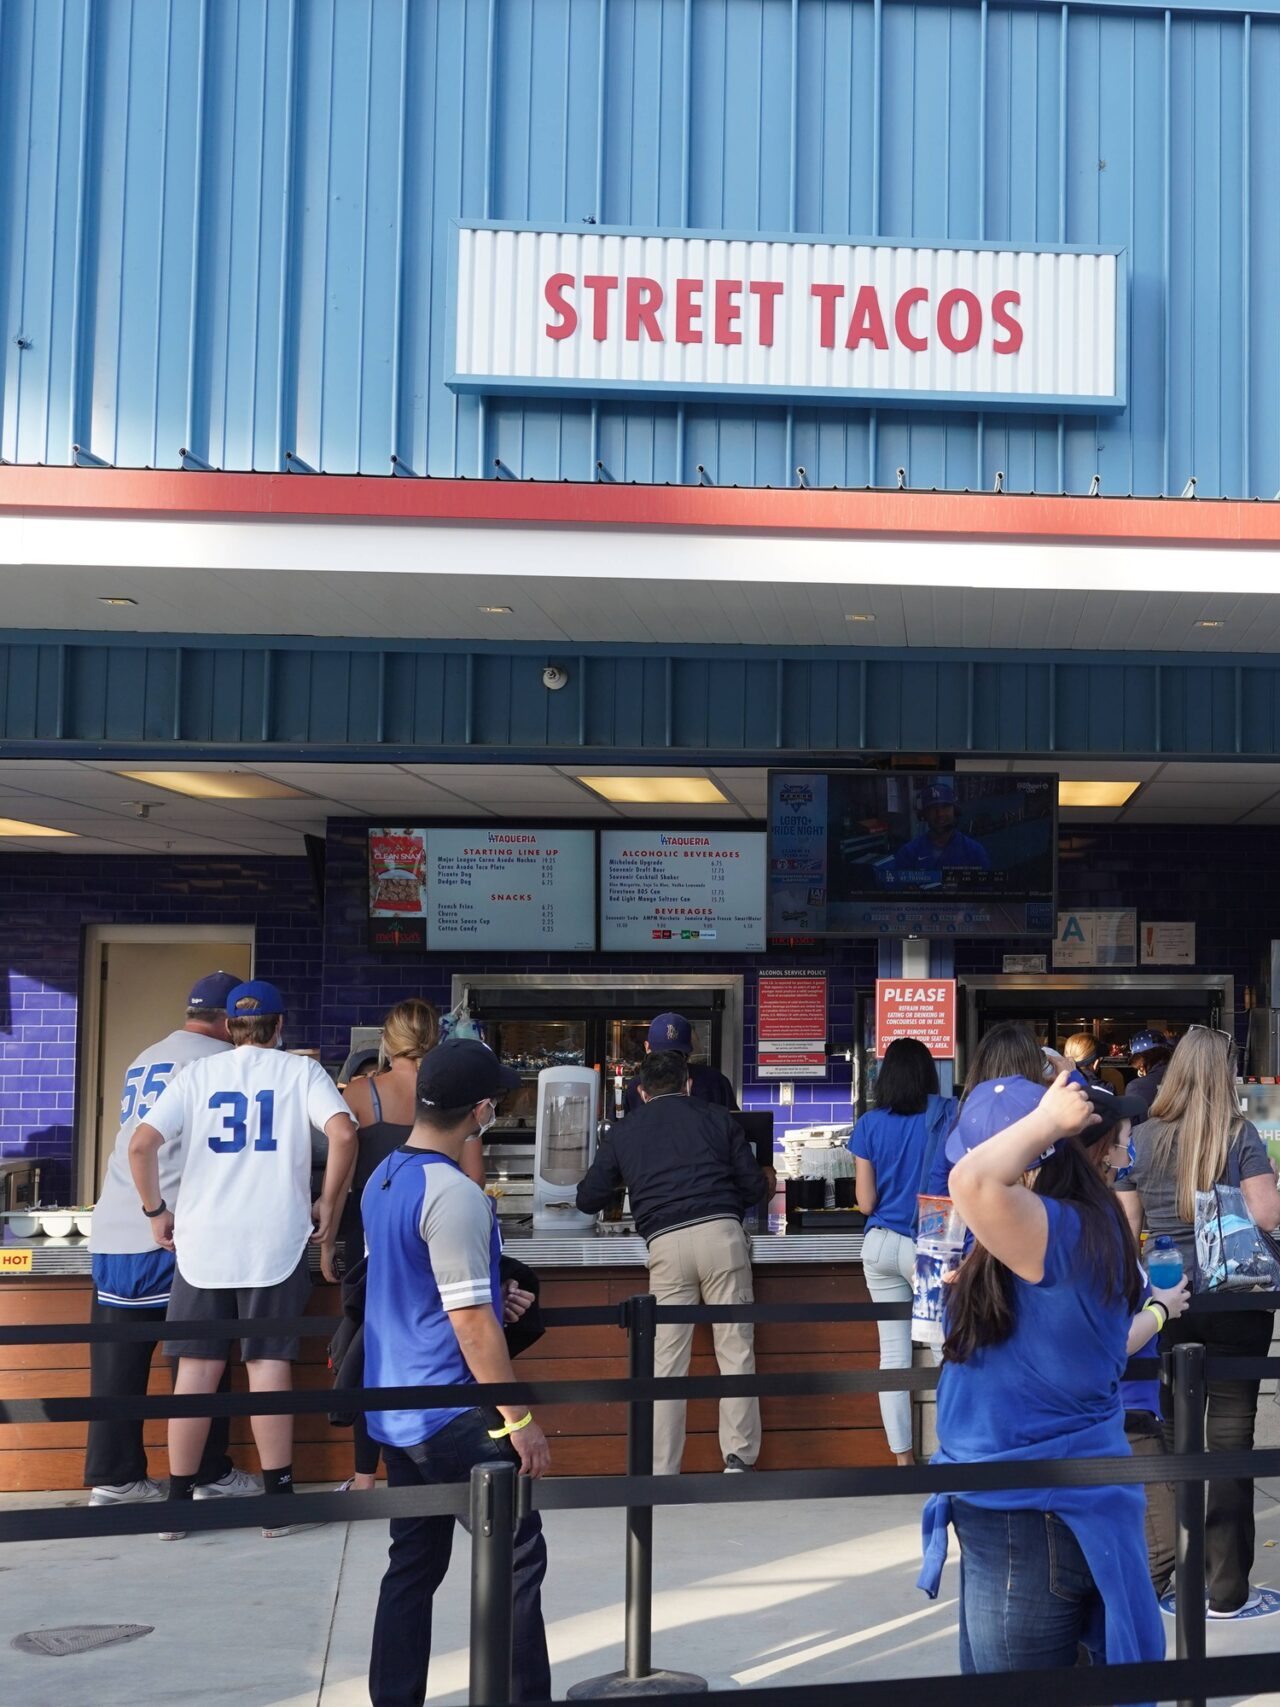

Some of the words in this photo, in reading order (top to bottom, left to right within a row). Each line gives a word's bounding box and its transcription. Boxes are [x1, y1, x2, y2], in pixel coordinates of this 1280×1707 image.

[545, 272, 784, 346] STREET
[811, 284, 1024, 354] TACOS
[797, 826, 824, 836] NIGHT
[1062, 917, 1085, 941] A
[884, 989, 946, 1002] PLEASE
[121, 1062, 176, 1127] 55
[207, 1089, 279, 1154] 31
[3, 1255, 28, 1266] HOT
